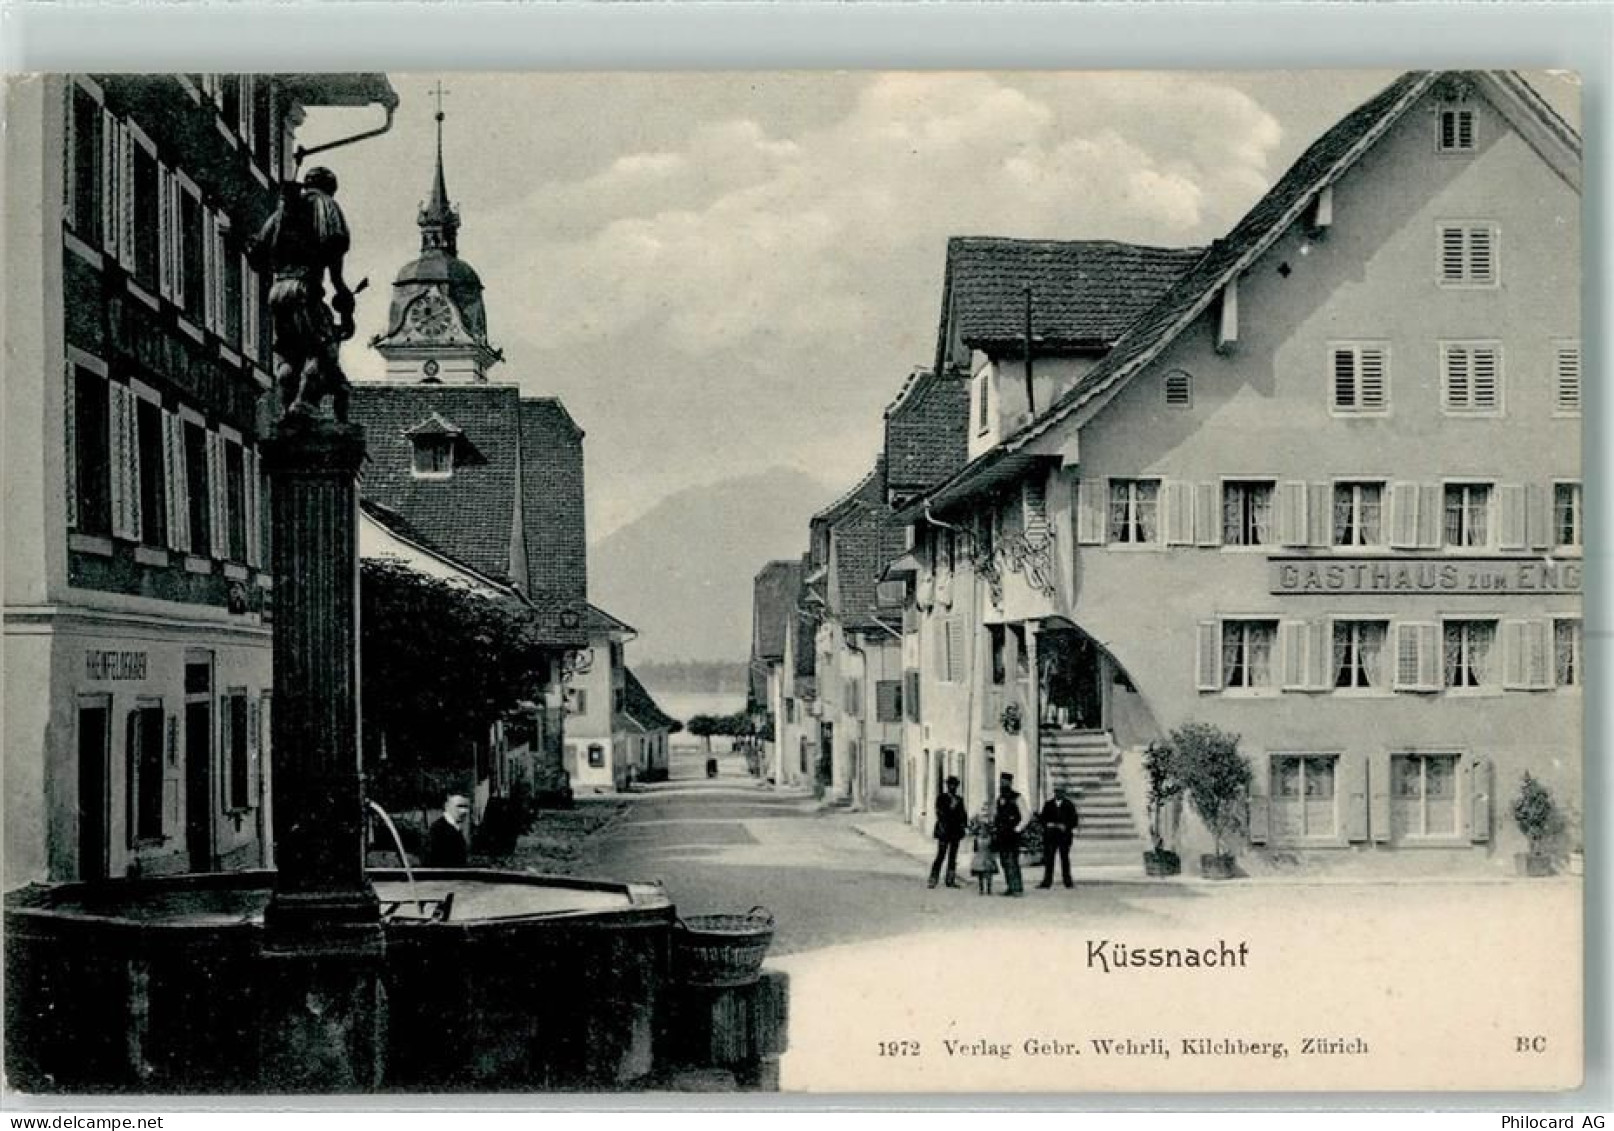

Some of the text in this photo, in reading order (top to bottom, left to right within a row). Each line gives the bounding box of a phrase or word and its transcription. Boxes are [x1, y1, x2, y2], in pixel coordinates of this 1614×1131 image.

[1279, 564, 1459, 589] GASTHAUS
[1467, 573, 1507, 590] ZUM
[1086, 940, 1249, 973] Küssnacht
[878, 1037, 1369, 1060] 1972 Verlag Gebr. Wehrli, Kilchberg, Zürich
[1515, 1036, 1547, 1053] BC
